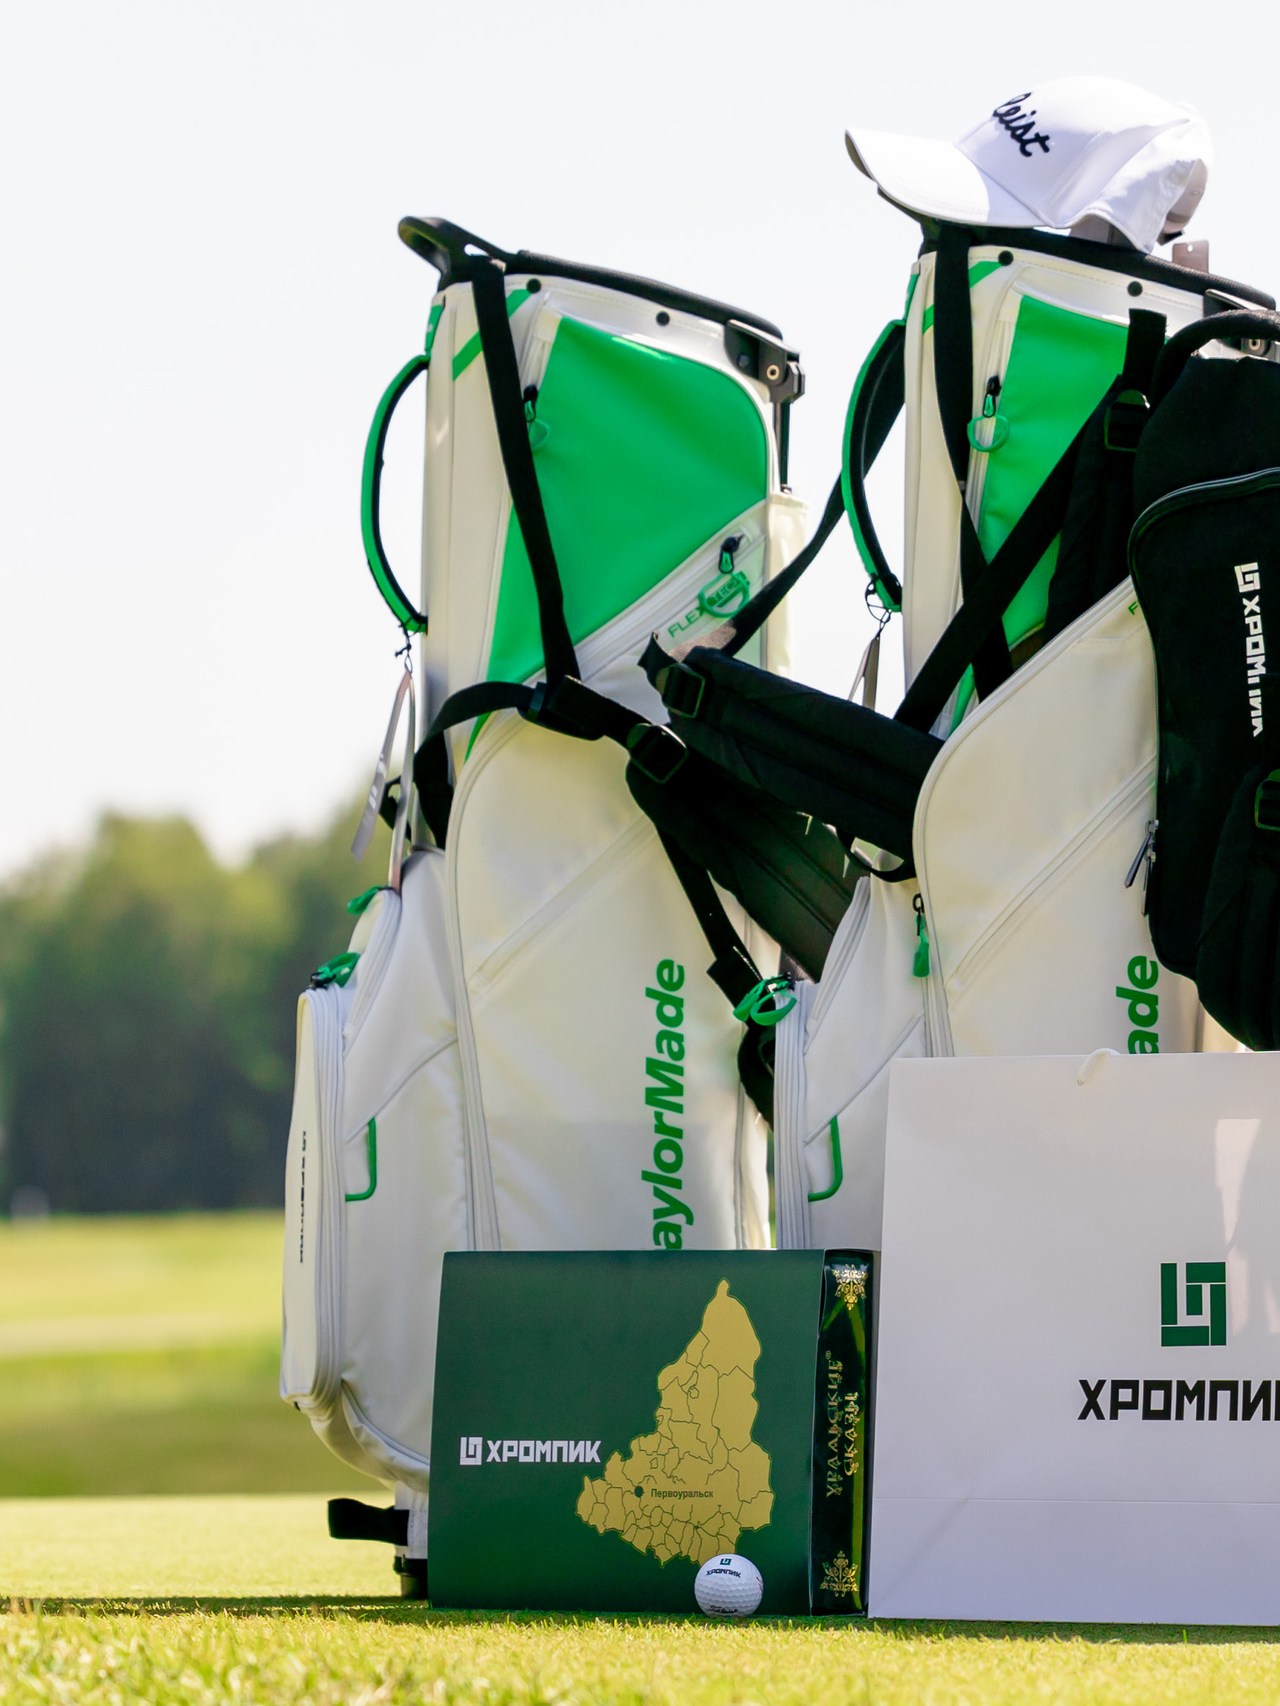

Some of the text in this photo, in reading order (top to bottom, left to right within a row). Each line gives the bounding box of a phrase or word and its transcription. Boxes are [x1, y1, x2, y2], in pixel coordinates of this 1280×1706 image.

[992, 91, 1050, 157] leist
[1115, 954, 1160, 1055] ade
[641, 958, 694, 1250] aylorMade
[486, 1440, 602, 1463] ХРОМПИК
[844, 1391, 861, 1477] СКАЗЫ
[650, 1488, 714, 1500] Первоуральск
[705, 1568, 742, 1578] ХРОМПИК
